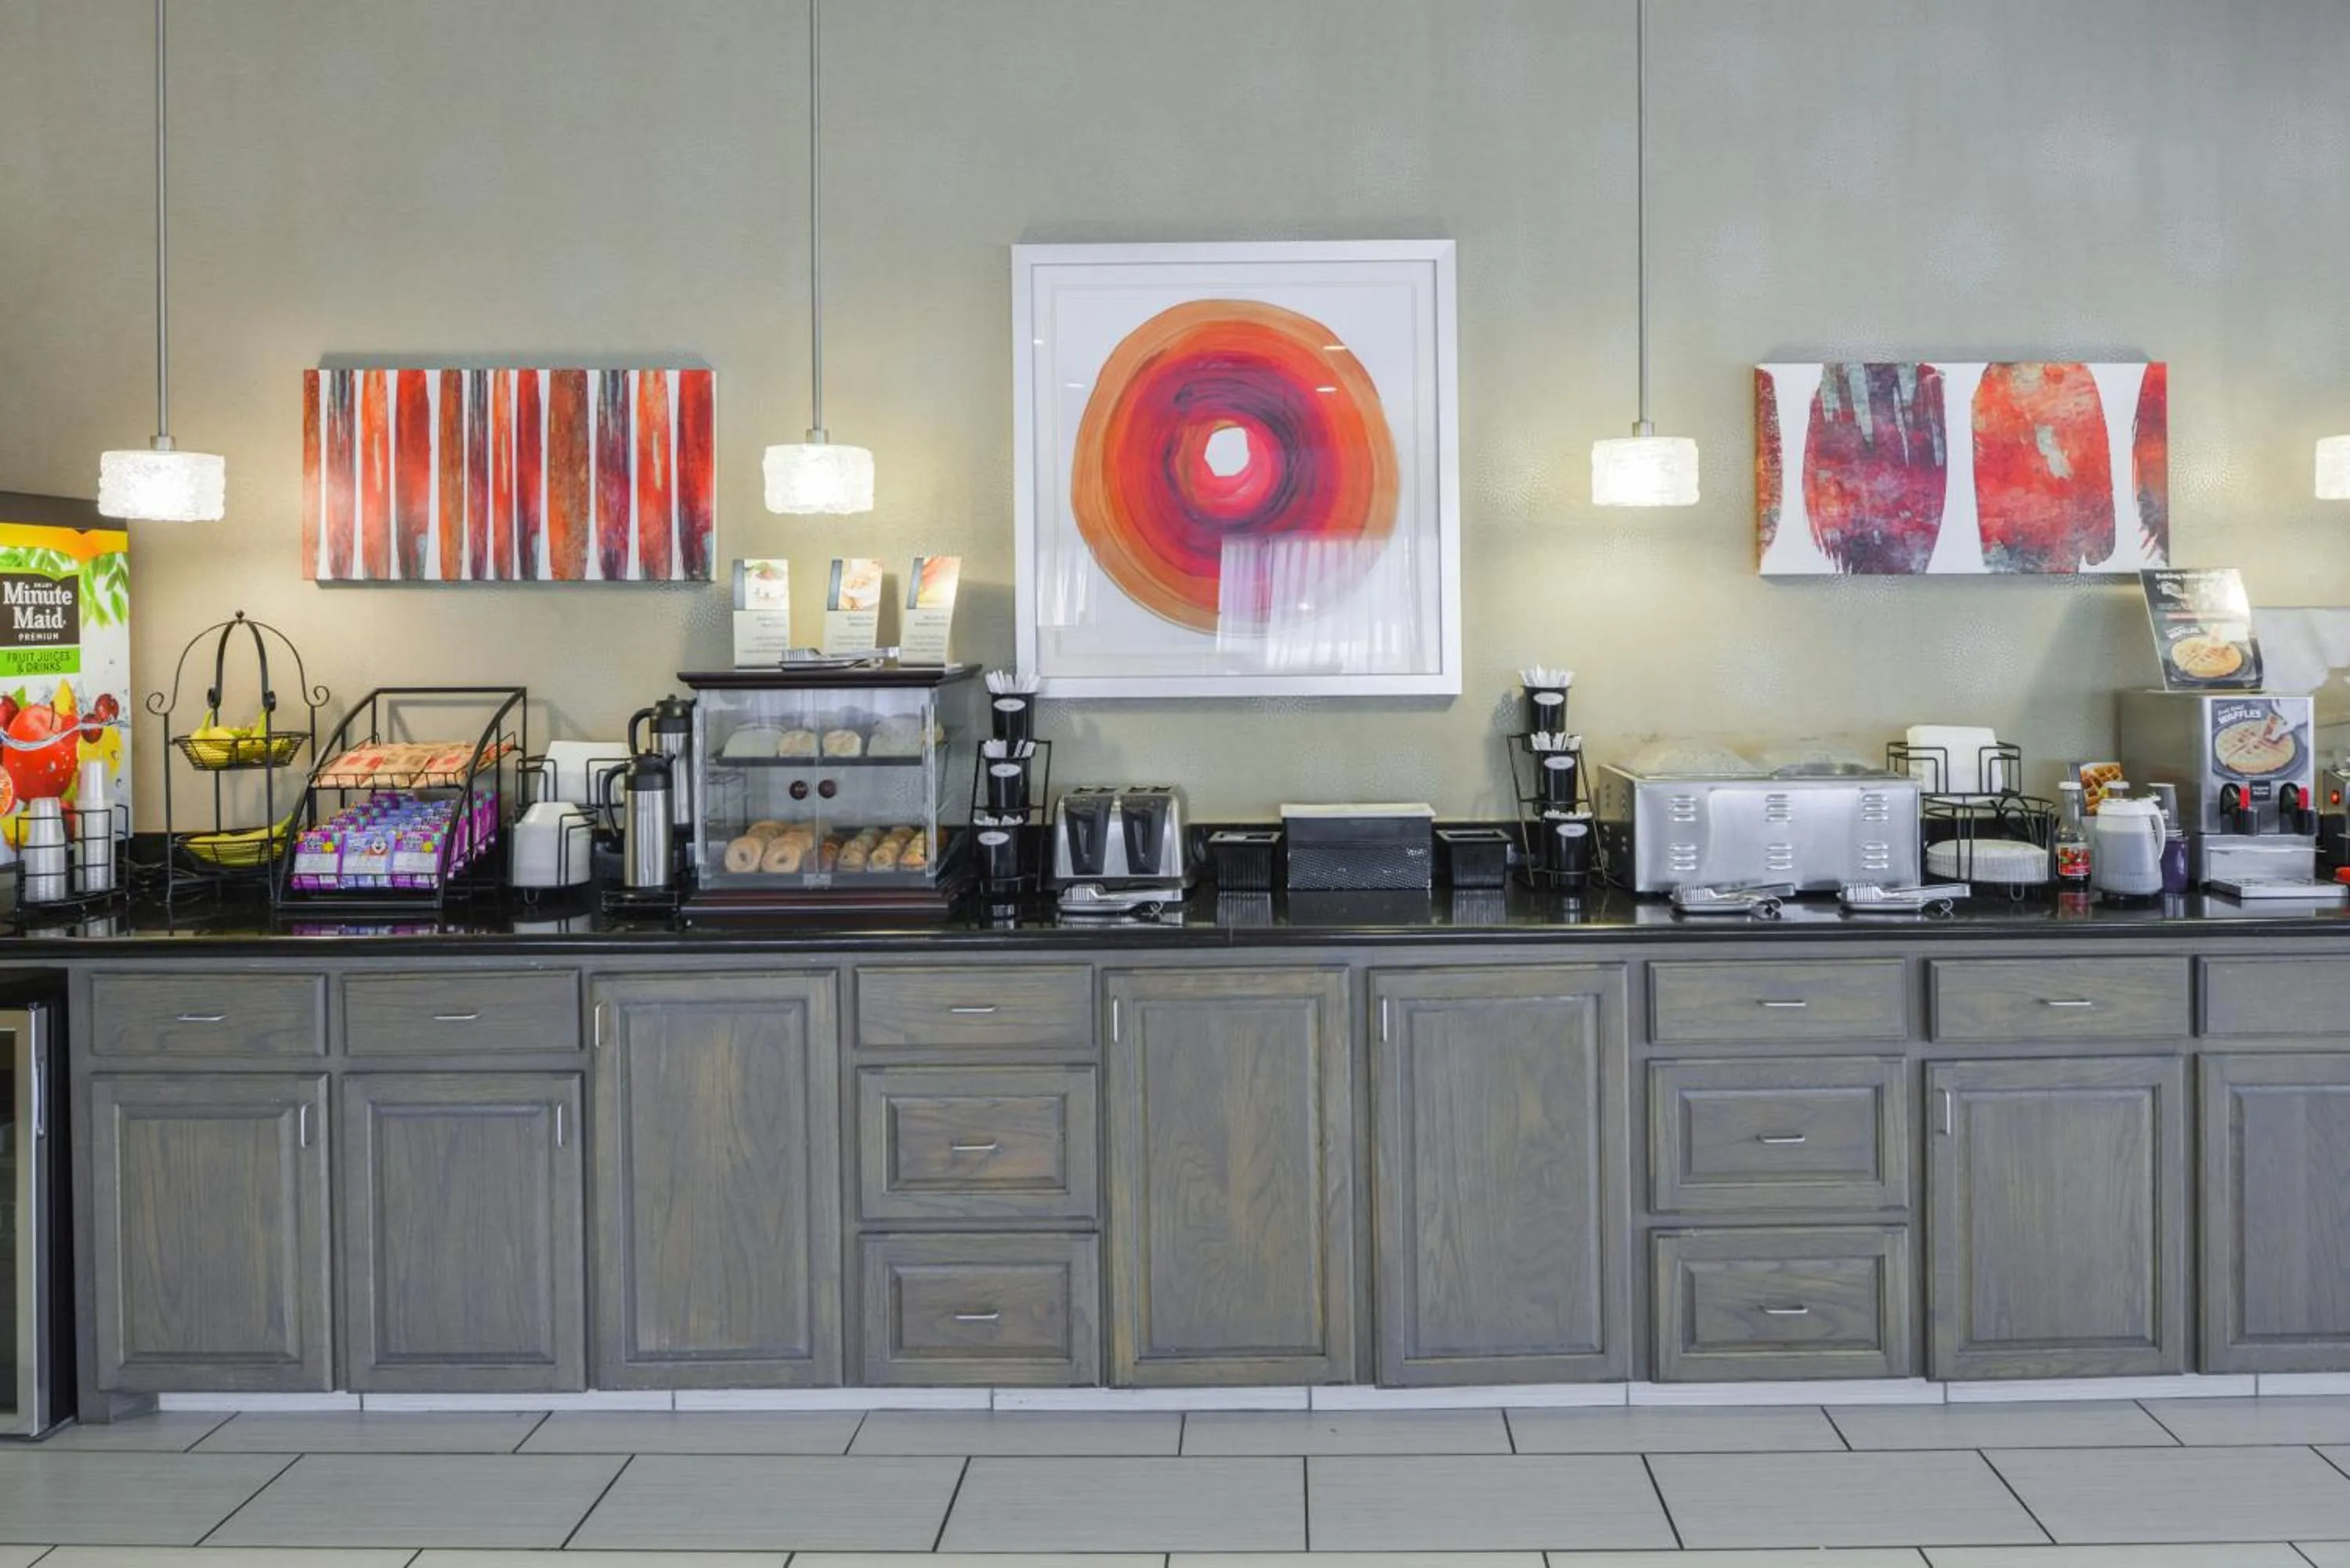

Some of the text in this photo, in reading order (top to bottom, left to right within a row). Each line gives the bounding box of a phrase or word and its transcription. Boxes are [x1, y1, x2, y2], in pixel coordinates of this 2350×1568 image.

[2, 580, 73, 605] Minute
[13, 606, 64, 629] Maid
[18, 632, 59, 641] PREMIUM
[6, 651, 70, 663] FRUIT JUICES
[26, 662, 61, 673] DRINKS
[2218, 710, 2261, 724] WAFFLES
